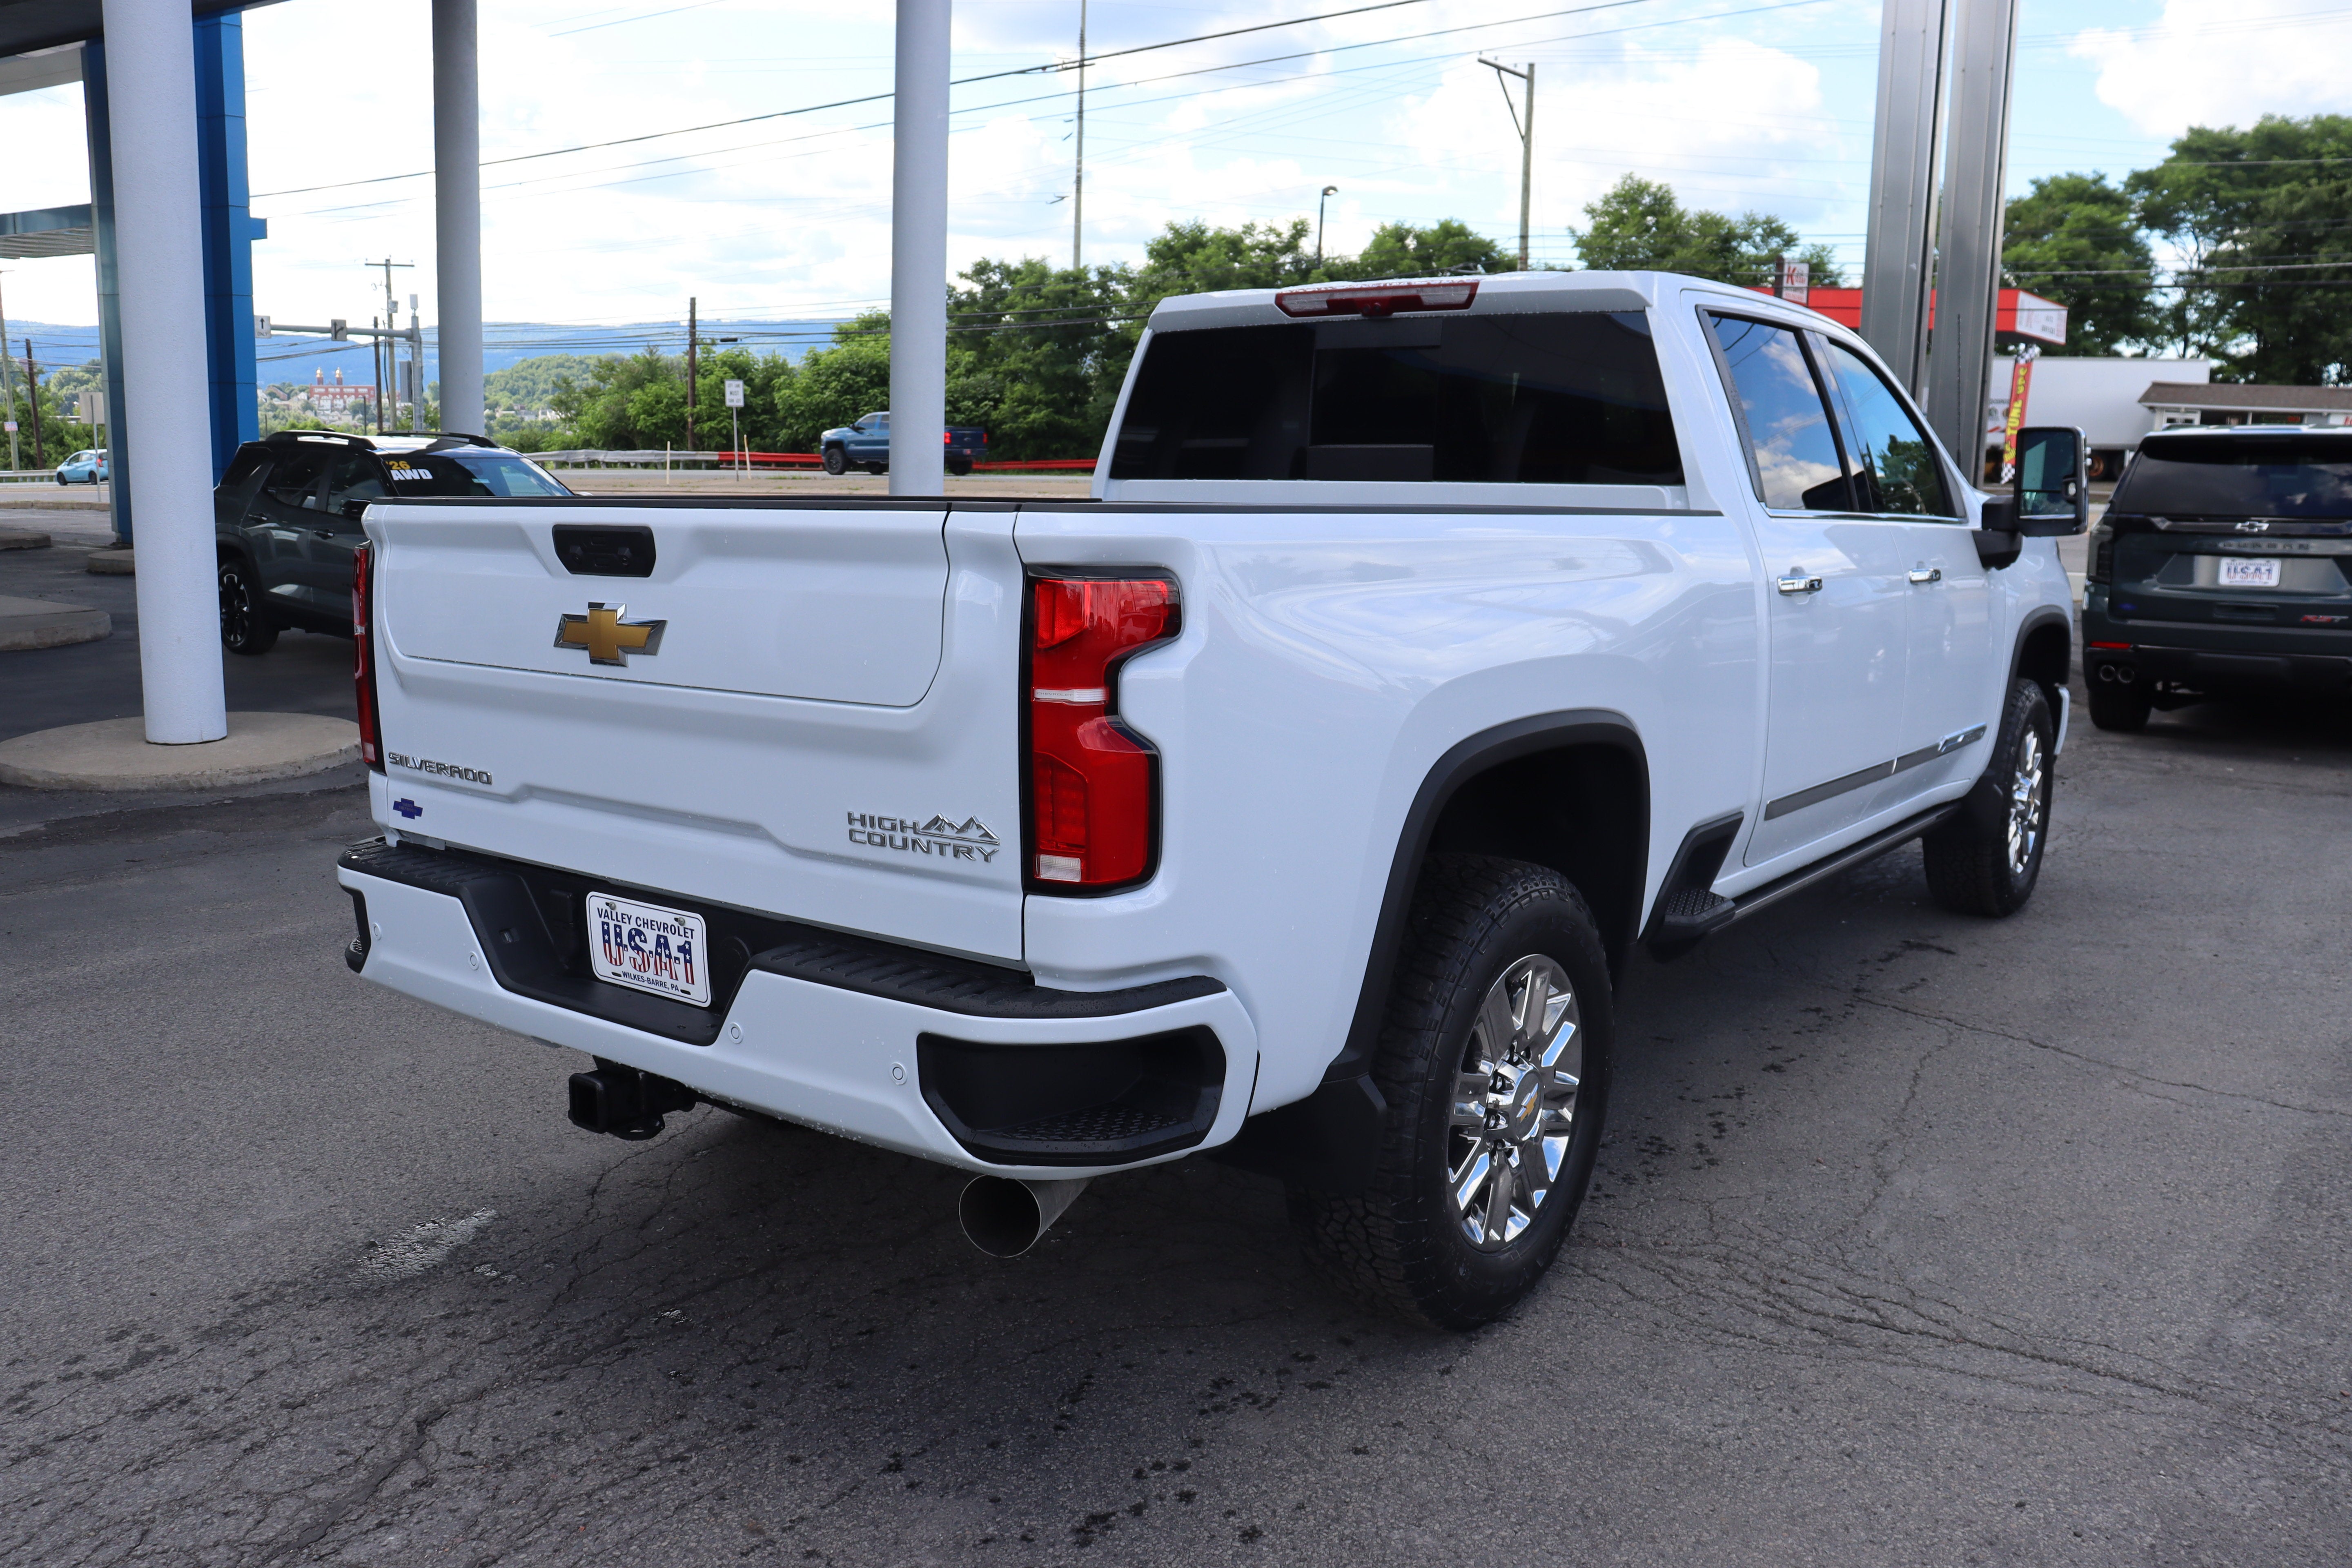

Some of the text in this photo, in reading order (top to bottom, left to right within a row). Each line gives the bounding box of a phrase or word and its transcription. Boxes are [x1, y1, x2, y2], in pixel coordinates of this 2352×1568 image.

[2007, 400, 2022, 436] TUNE
[385, 461, 410, 470] '26
[390, 469, 433, 481] AWD
[388, 751, 492, 785] SILVERADO
[847, 811, 920, 834] HIGH
[849, 828, 1000, 862] COUNTRY
[597, 907, 695, 939] VALLEY CHEVROLET
[622, 971, 679, 992] WILKES-BARRE, PA
